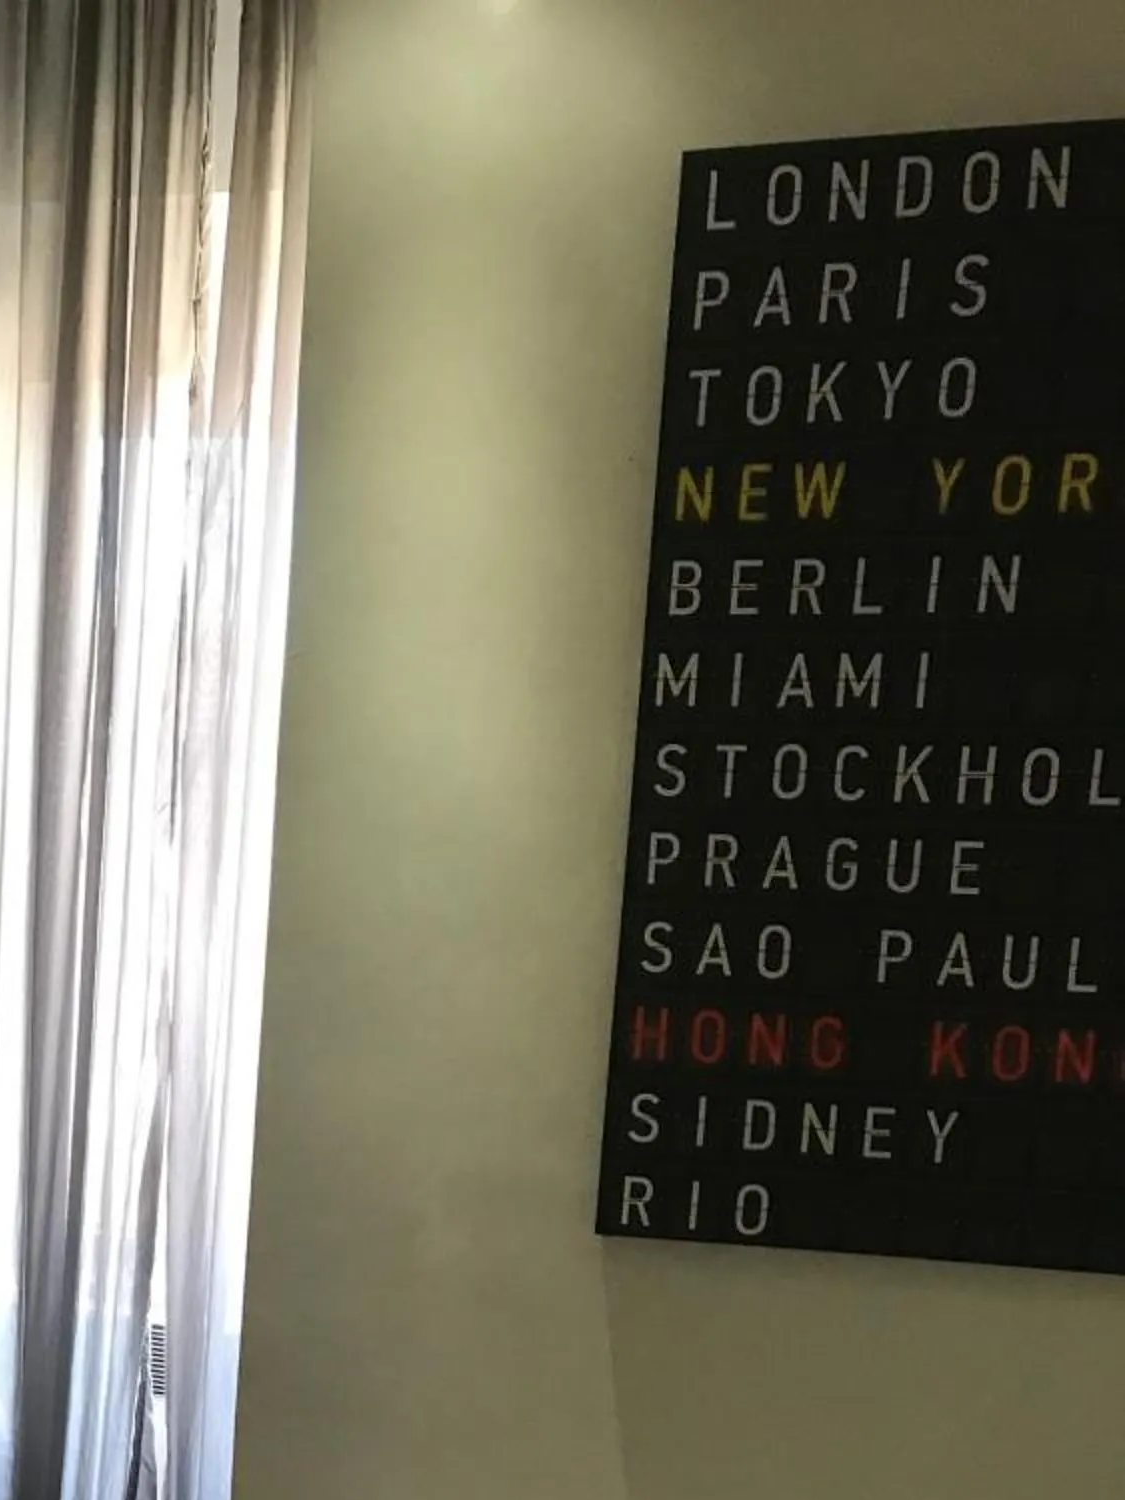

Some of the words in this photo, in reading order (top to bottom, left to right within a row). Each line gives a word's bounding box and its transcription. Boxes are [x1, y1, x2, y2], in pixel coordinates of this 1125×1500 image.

[705, 145, 1071, 231] LONDON
[693, 254, 990, 331] PARIS
[689, 357, 977, 427] TOKYO
[675, 461, 846, 522] NEW
[668, 554, 1021, 616] BERLIN
[655, 652, 929, 709] MIAMI
[653, 743, 1121, 806] STOCKHOL
[646, 831, 985, 895] PRAGUE
[640, 921, 792, 980] SAO
[877, 929, 1098, 993] PAUL
[630, 1006, 846, 1070] HONG
[929, 1020, 1125, 1084] KON
[627, 1093, 959, 1164] SIDNEY
[620, 1175, 770, 1235] RIO
